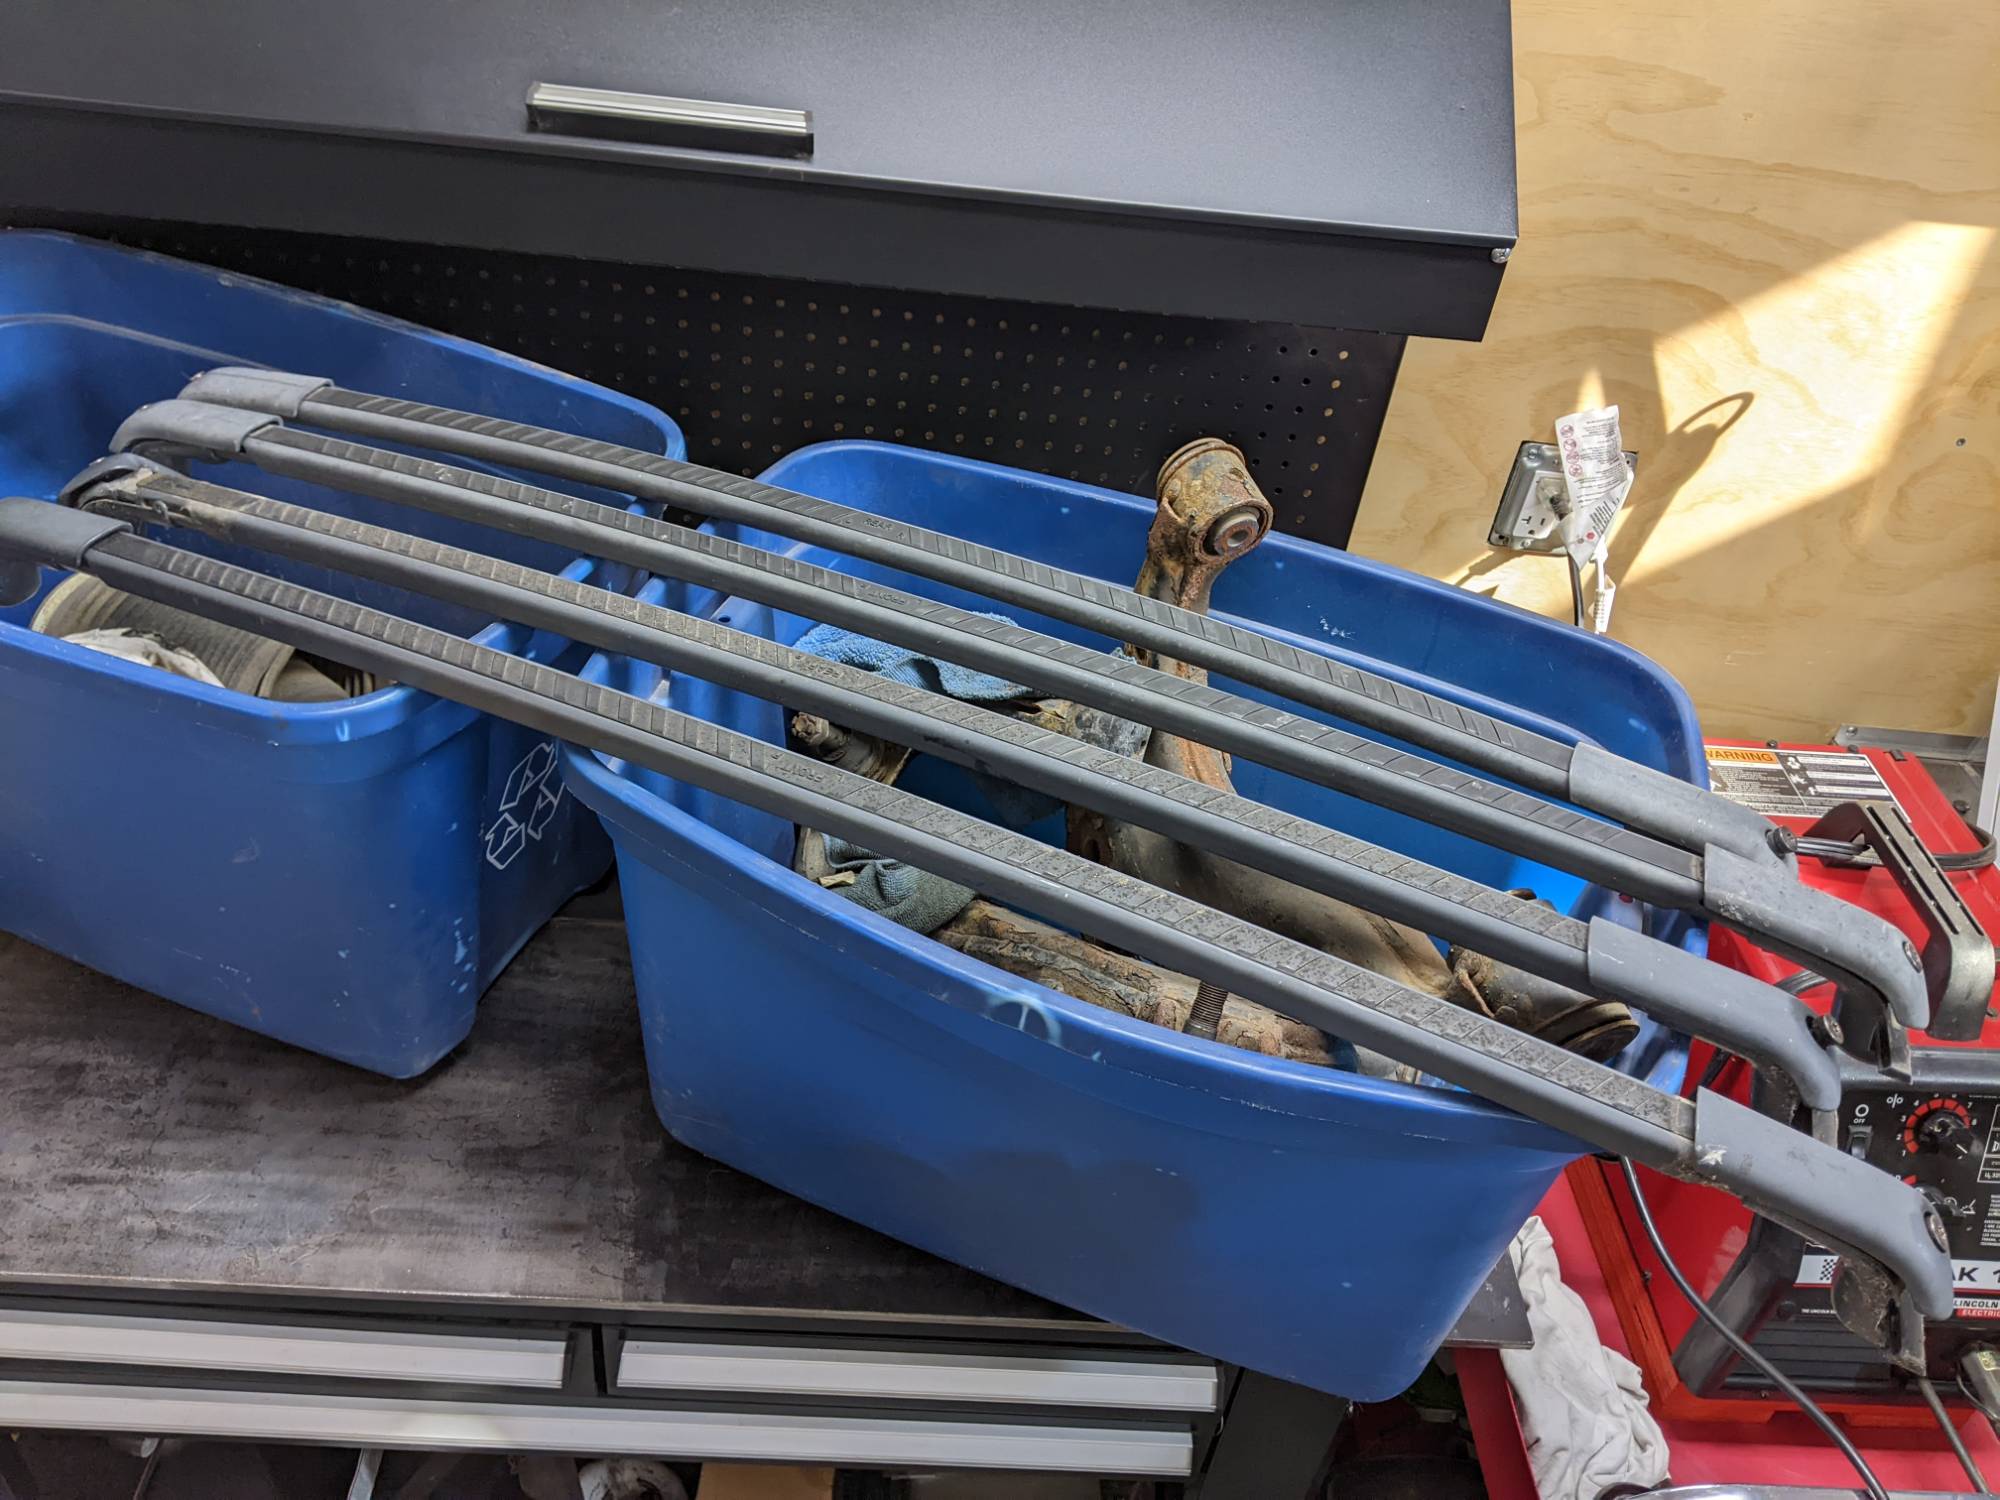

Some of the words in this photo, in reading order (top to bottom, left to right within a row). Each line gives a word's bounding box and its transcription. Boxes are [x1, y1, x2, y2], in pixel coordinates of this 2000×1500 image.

[1902, 1149, 1907, 1157] 1
[1952, 1266, 1979, 1282] K
[1953, 1300, 1999, 1308] LINCOLN
